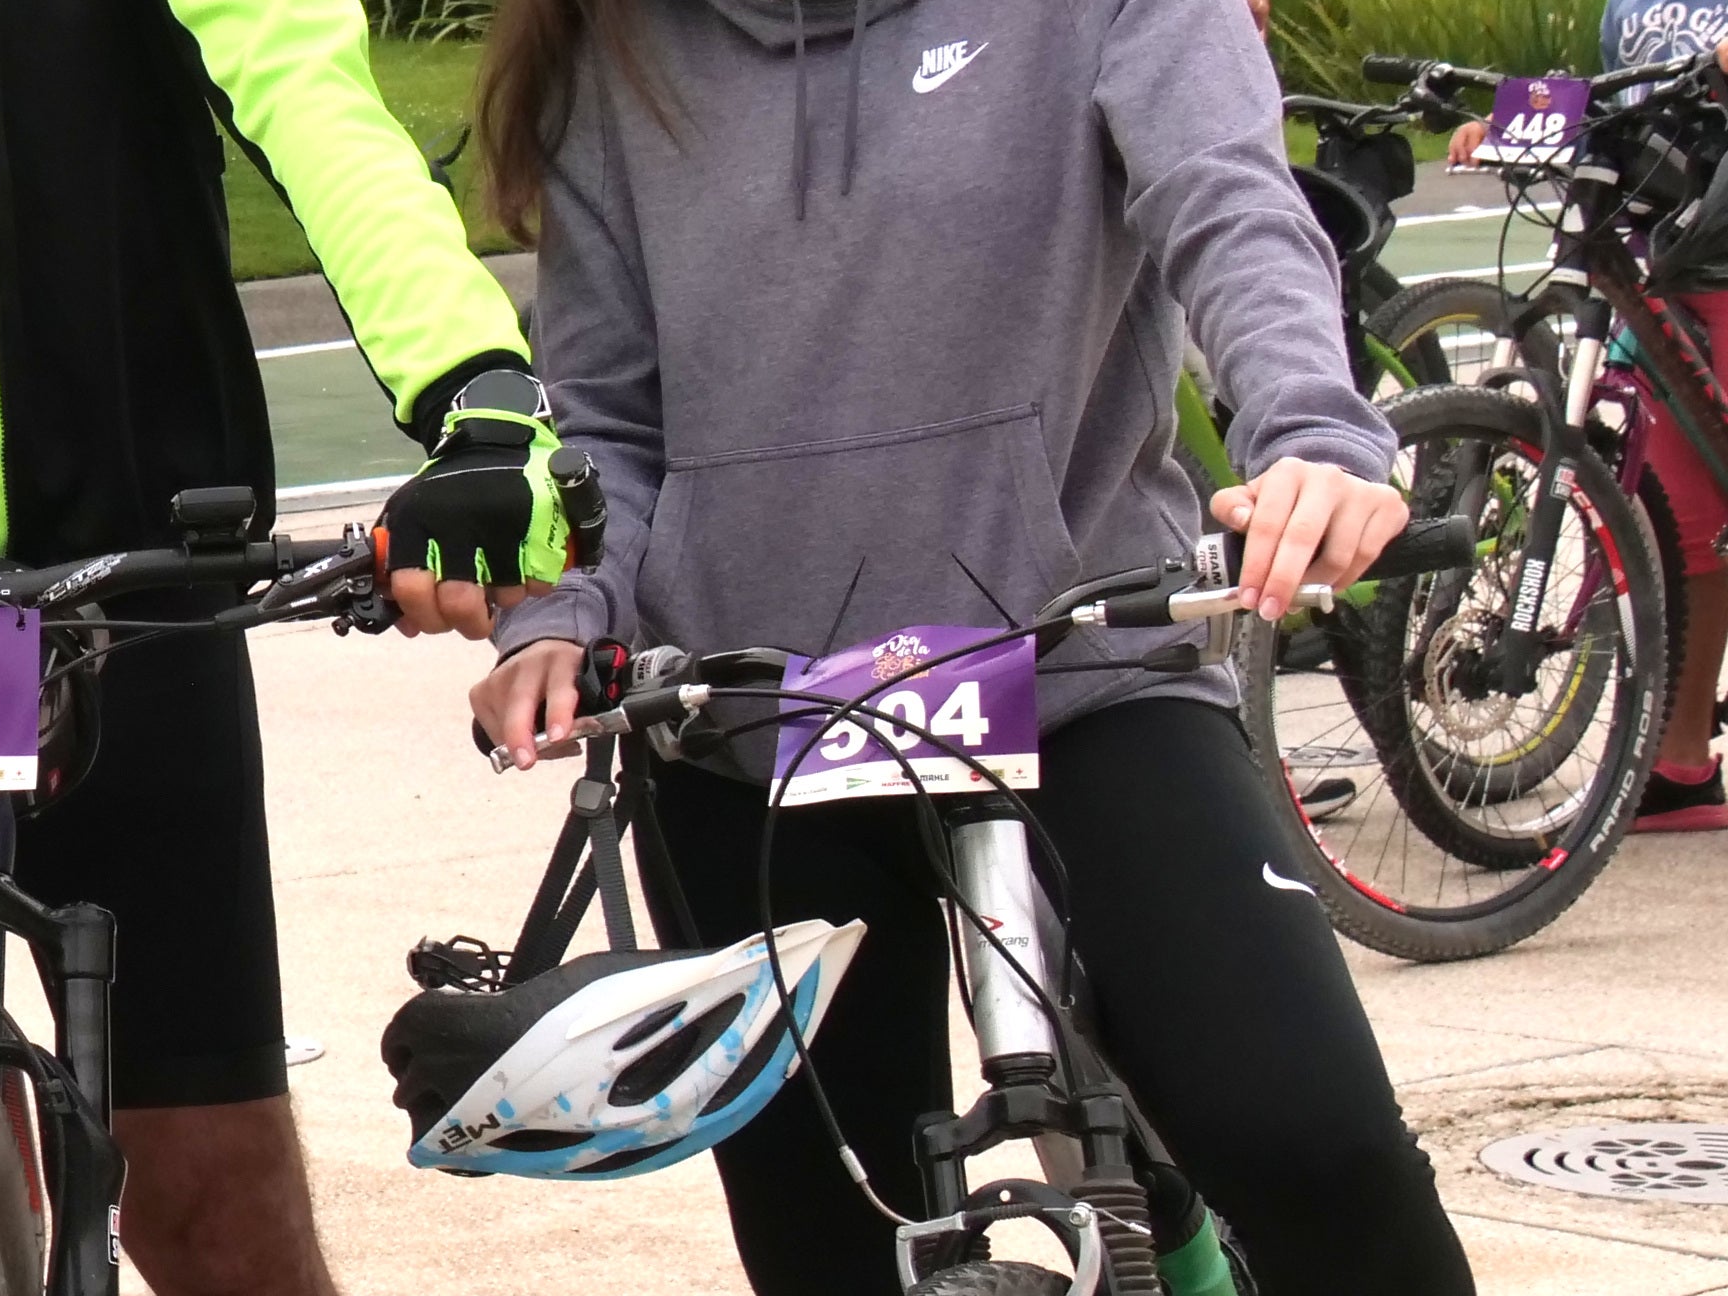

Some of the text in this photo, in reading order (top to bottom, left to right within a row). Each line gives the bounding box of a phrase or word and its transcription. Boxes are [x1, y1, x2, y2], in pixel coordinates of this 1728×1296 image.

[1642, 2, 1688, 28] GO
[921, 40, 968, 77] NIKE
[1501, 112, 1566, 145] 448
[1207, 543, 1224, 585] SRAM
[1510, 558, 1547, 633] ROCKSHOX
[819, 680, 990, 761] 504
[437, 1112, 502, 1155] MET
